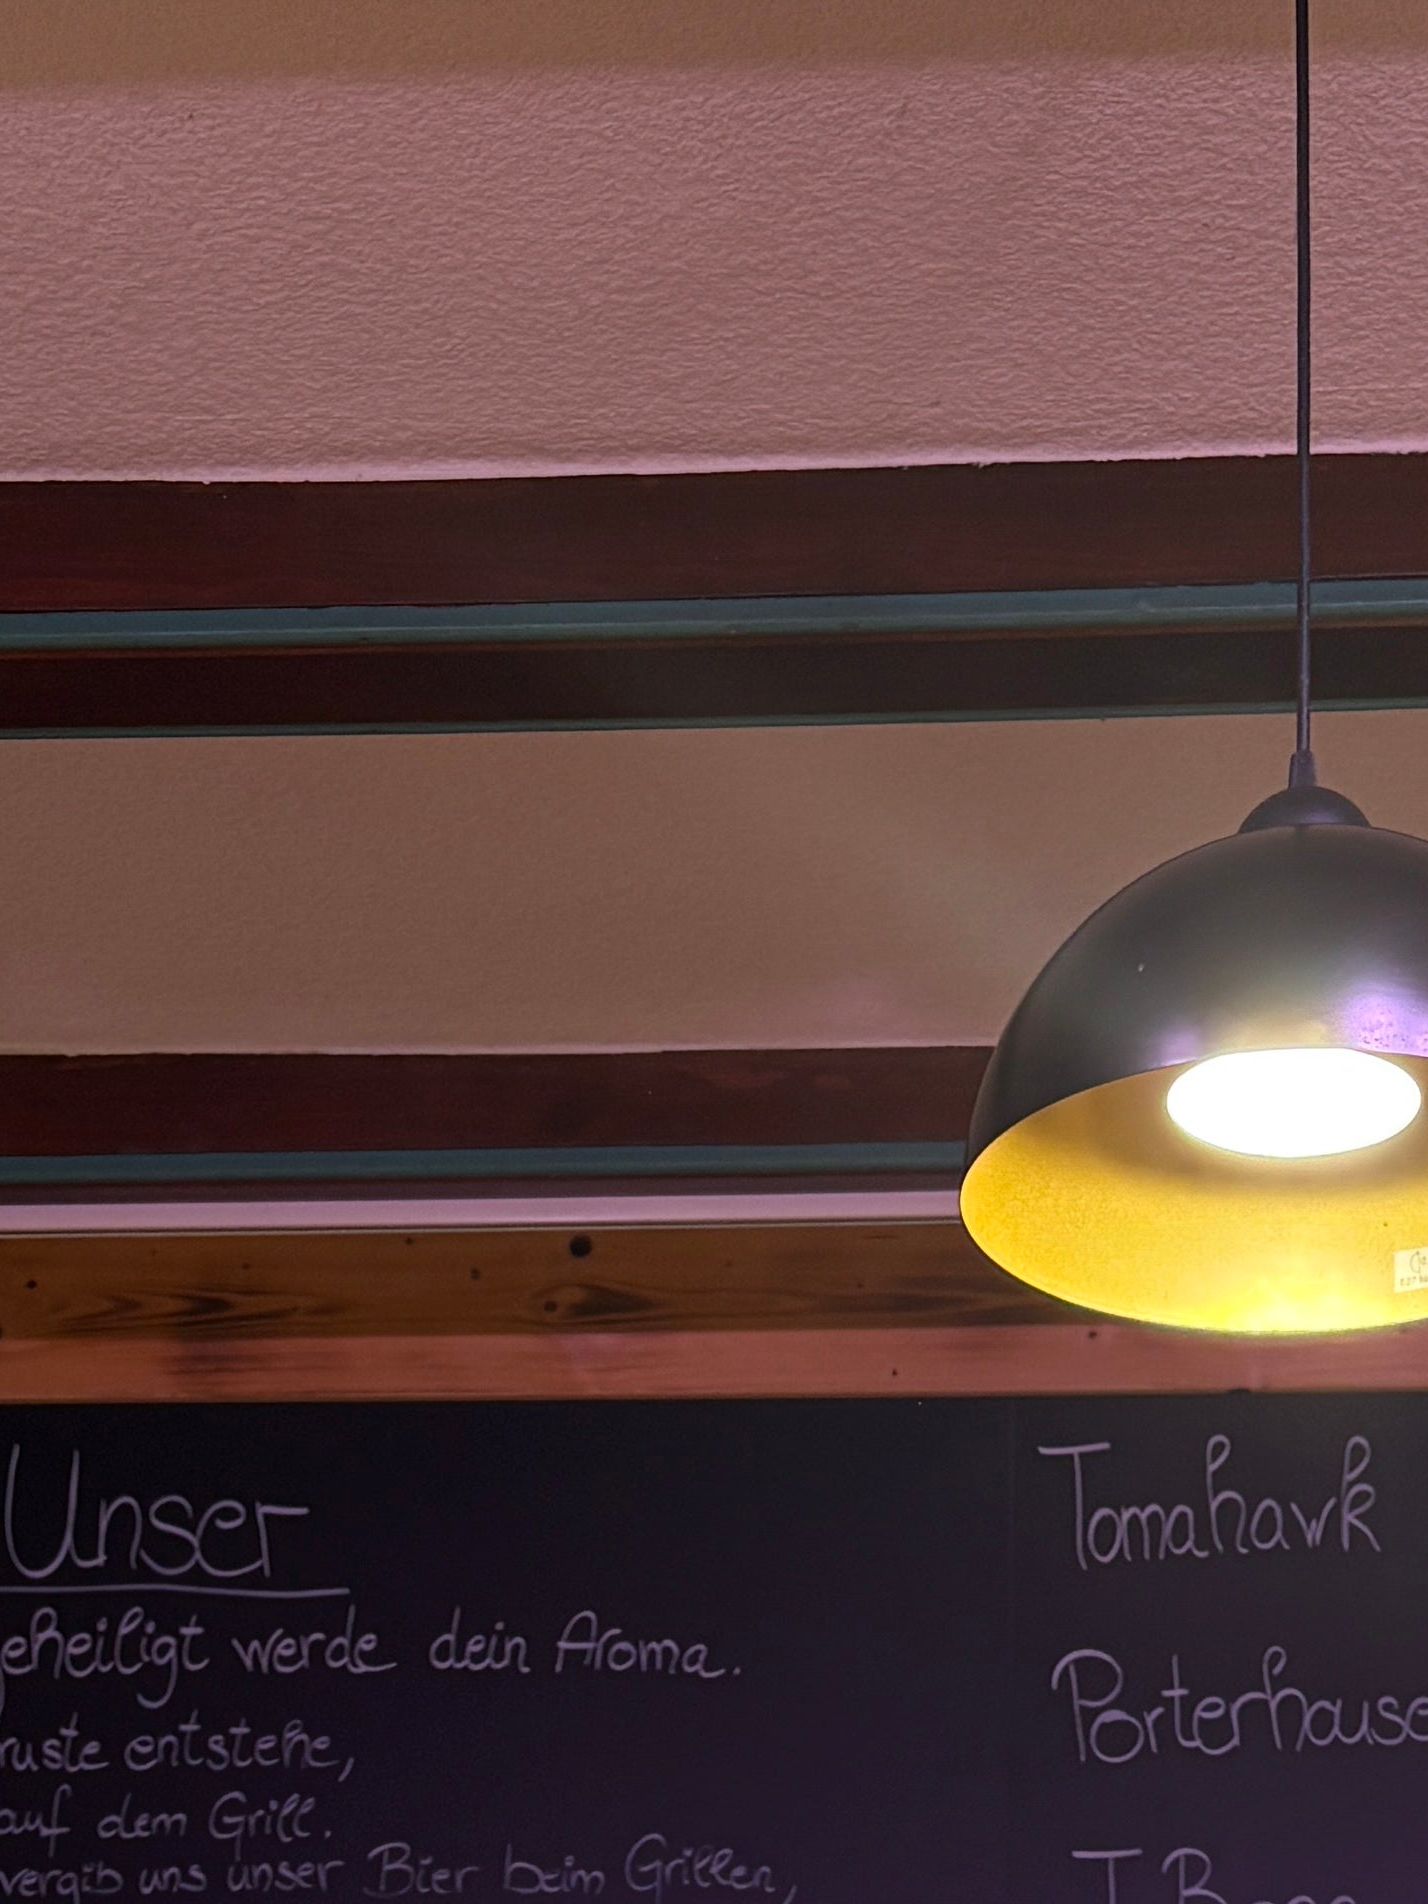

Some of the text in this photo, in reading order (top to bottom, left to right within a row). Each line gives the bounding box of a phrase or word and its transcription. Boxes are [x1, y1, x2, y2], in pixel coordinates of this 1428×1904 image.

[3, 1443, 310, 1579] Unser
[1037, 1433, 1382, 1571] Tomahawk
[231, 1605, 398, 1675] werde
[428, 1604, 531, 1674] dein
[554, 1609, 743, 1679] Aroma.
[123, 1712, 355, 1782] entstehe,
[96, 1796, 188, 1840] dem
[208, 1790, 333, 1862] Grill.
[138, 1860, 208, 1896] uns
[225, 1855, 345, 1893] unser
[362, 1841, 479, 1899] Bier
[504, 1842, 606, 1896] beim
